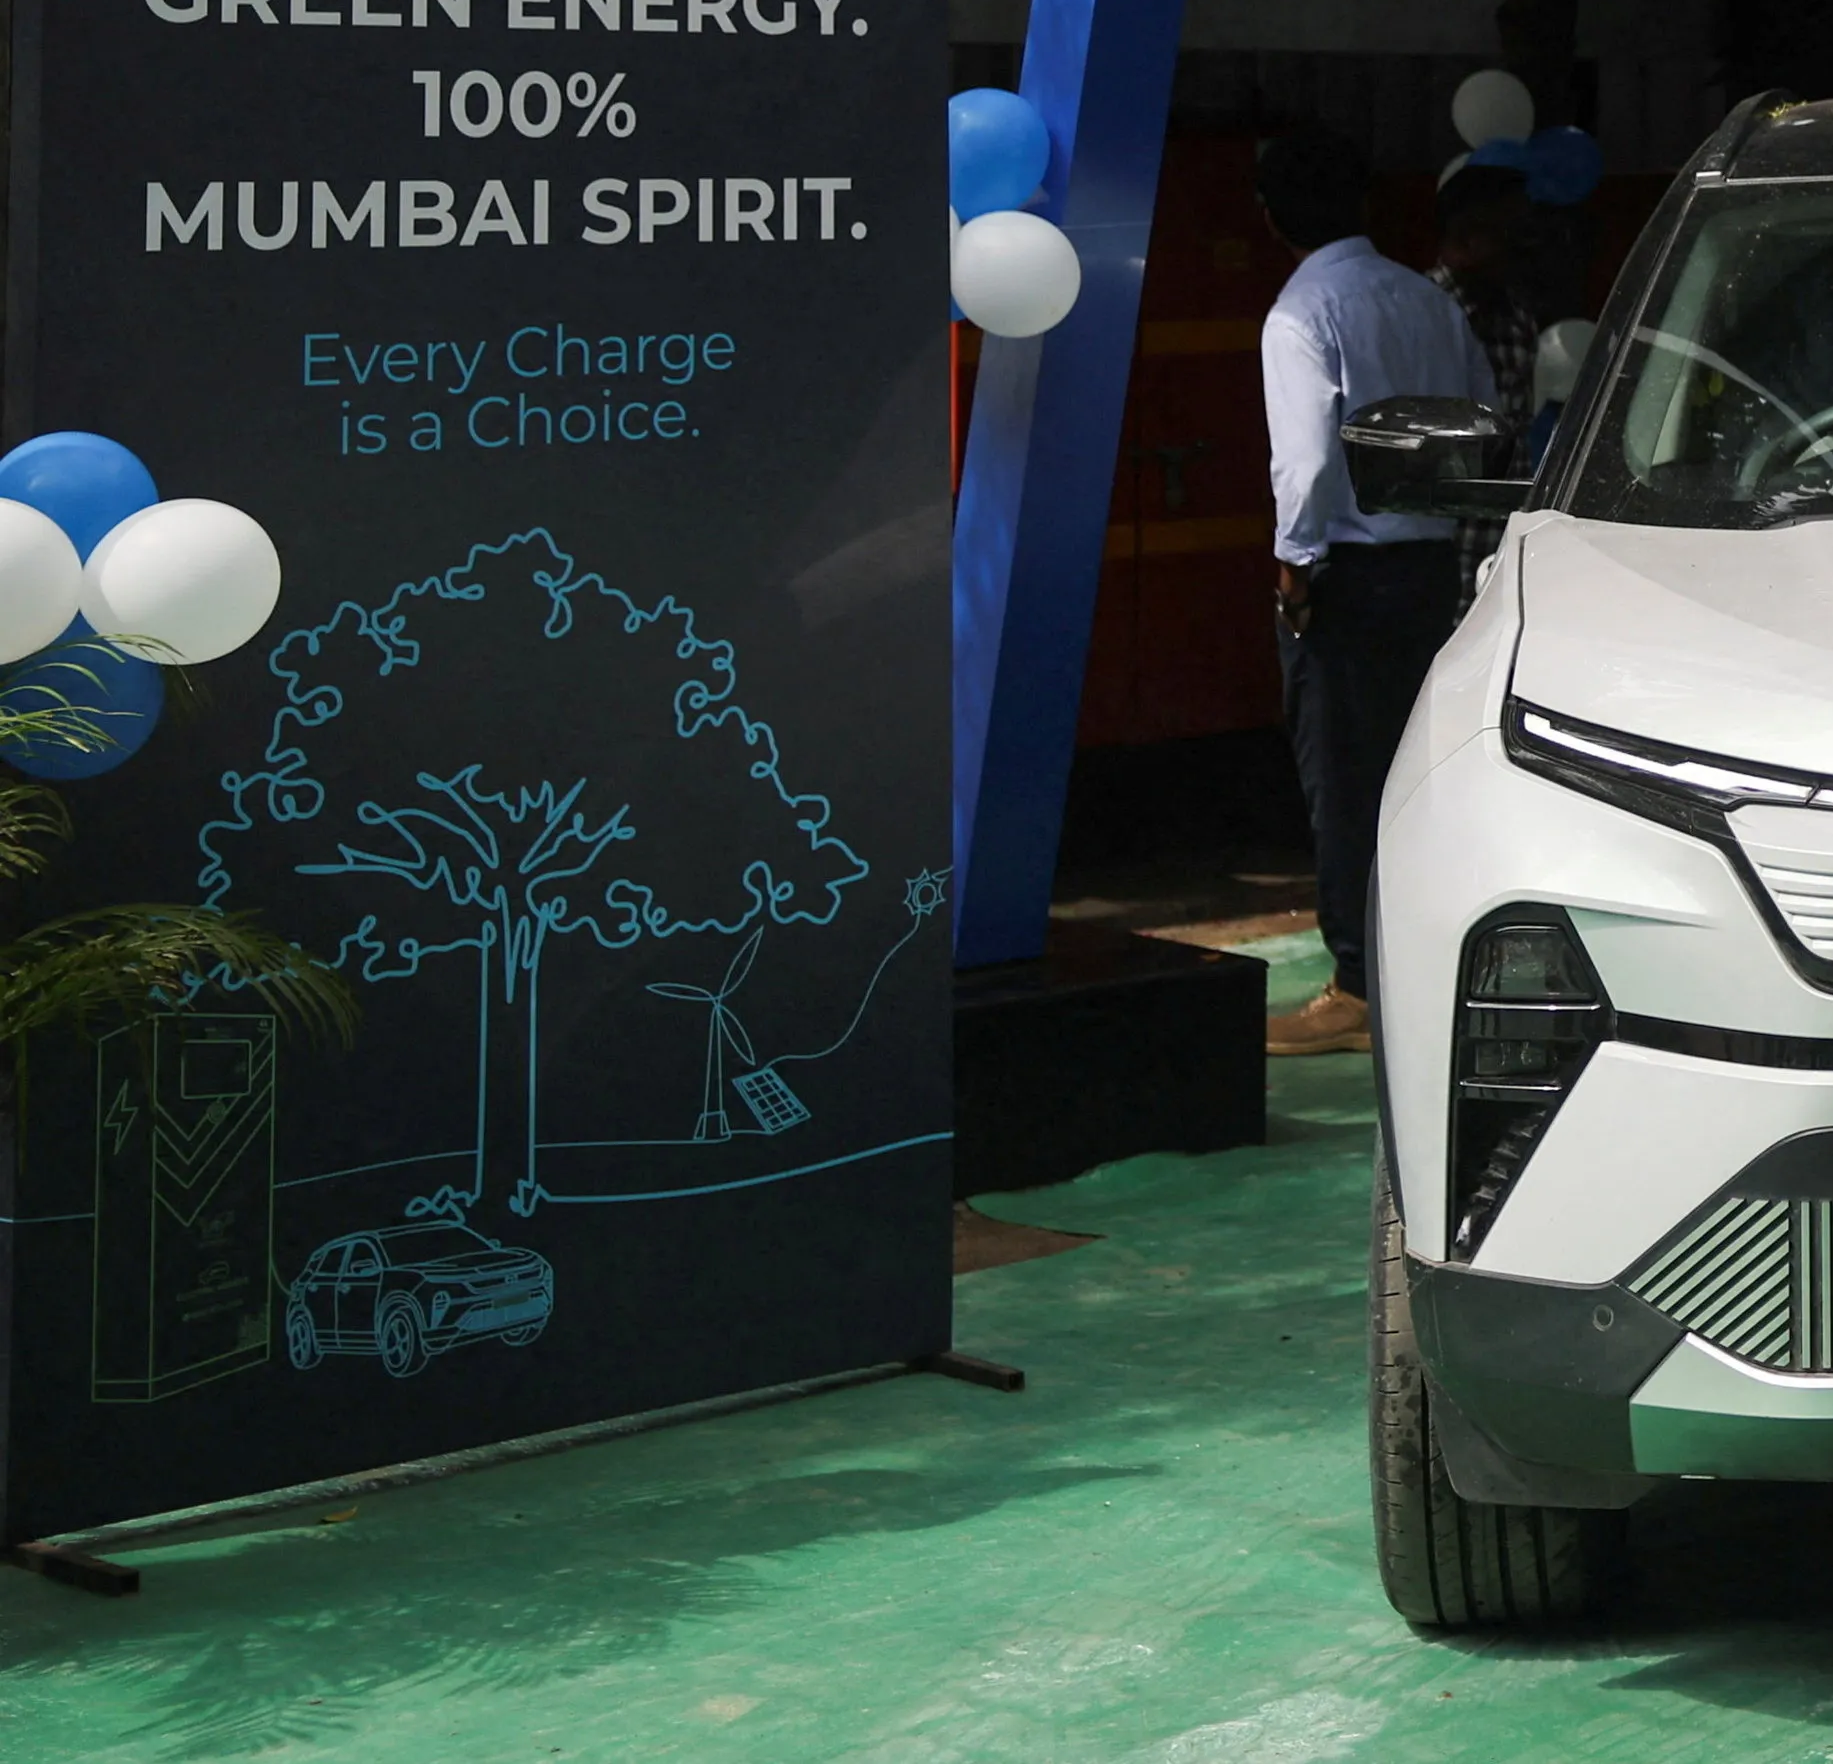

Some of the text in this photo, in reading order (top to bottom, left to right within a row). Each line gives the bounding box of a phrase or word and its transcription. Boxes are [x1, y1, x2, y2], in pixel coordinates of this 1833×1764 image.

[412, 70, 636, 138] 100%
[145, 177, 867, 252] MUMBAI SPIRIT.
[304, 323, 735, 394] Every Charge
[342, 390, 700, 455] is a Choice.
